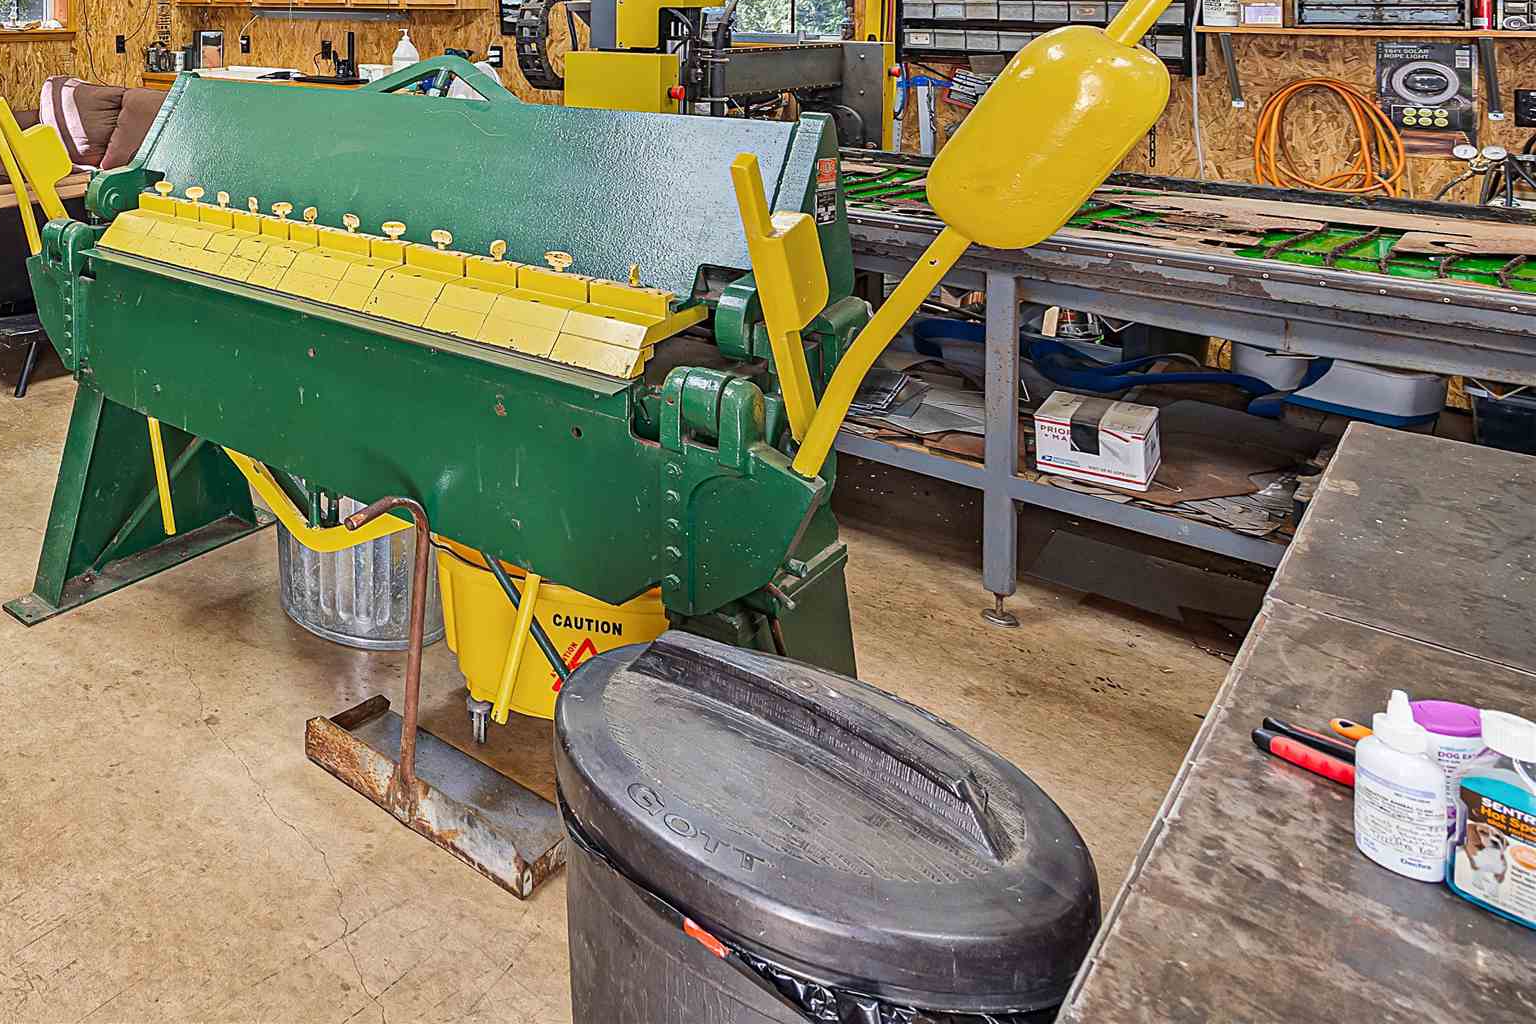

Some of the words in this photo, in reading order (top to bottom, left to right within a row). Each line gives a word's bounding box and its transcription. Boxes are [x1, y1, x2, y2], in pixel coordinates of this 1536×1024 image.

[1052, 434, 1068, 442] MA
[552, 613, 624, 637] CAUTION
[1437, 751, 1460, 760] DOG
[1480, 797, 1536, 822] SENTR
[1480, 804, 1507, 824] Hot
[1509, 817, 1536, 837] Spo
[626, 782, 767, 873] GOTT
